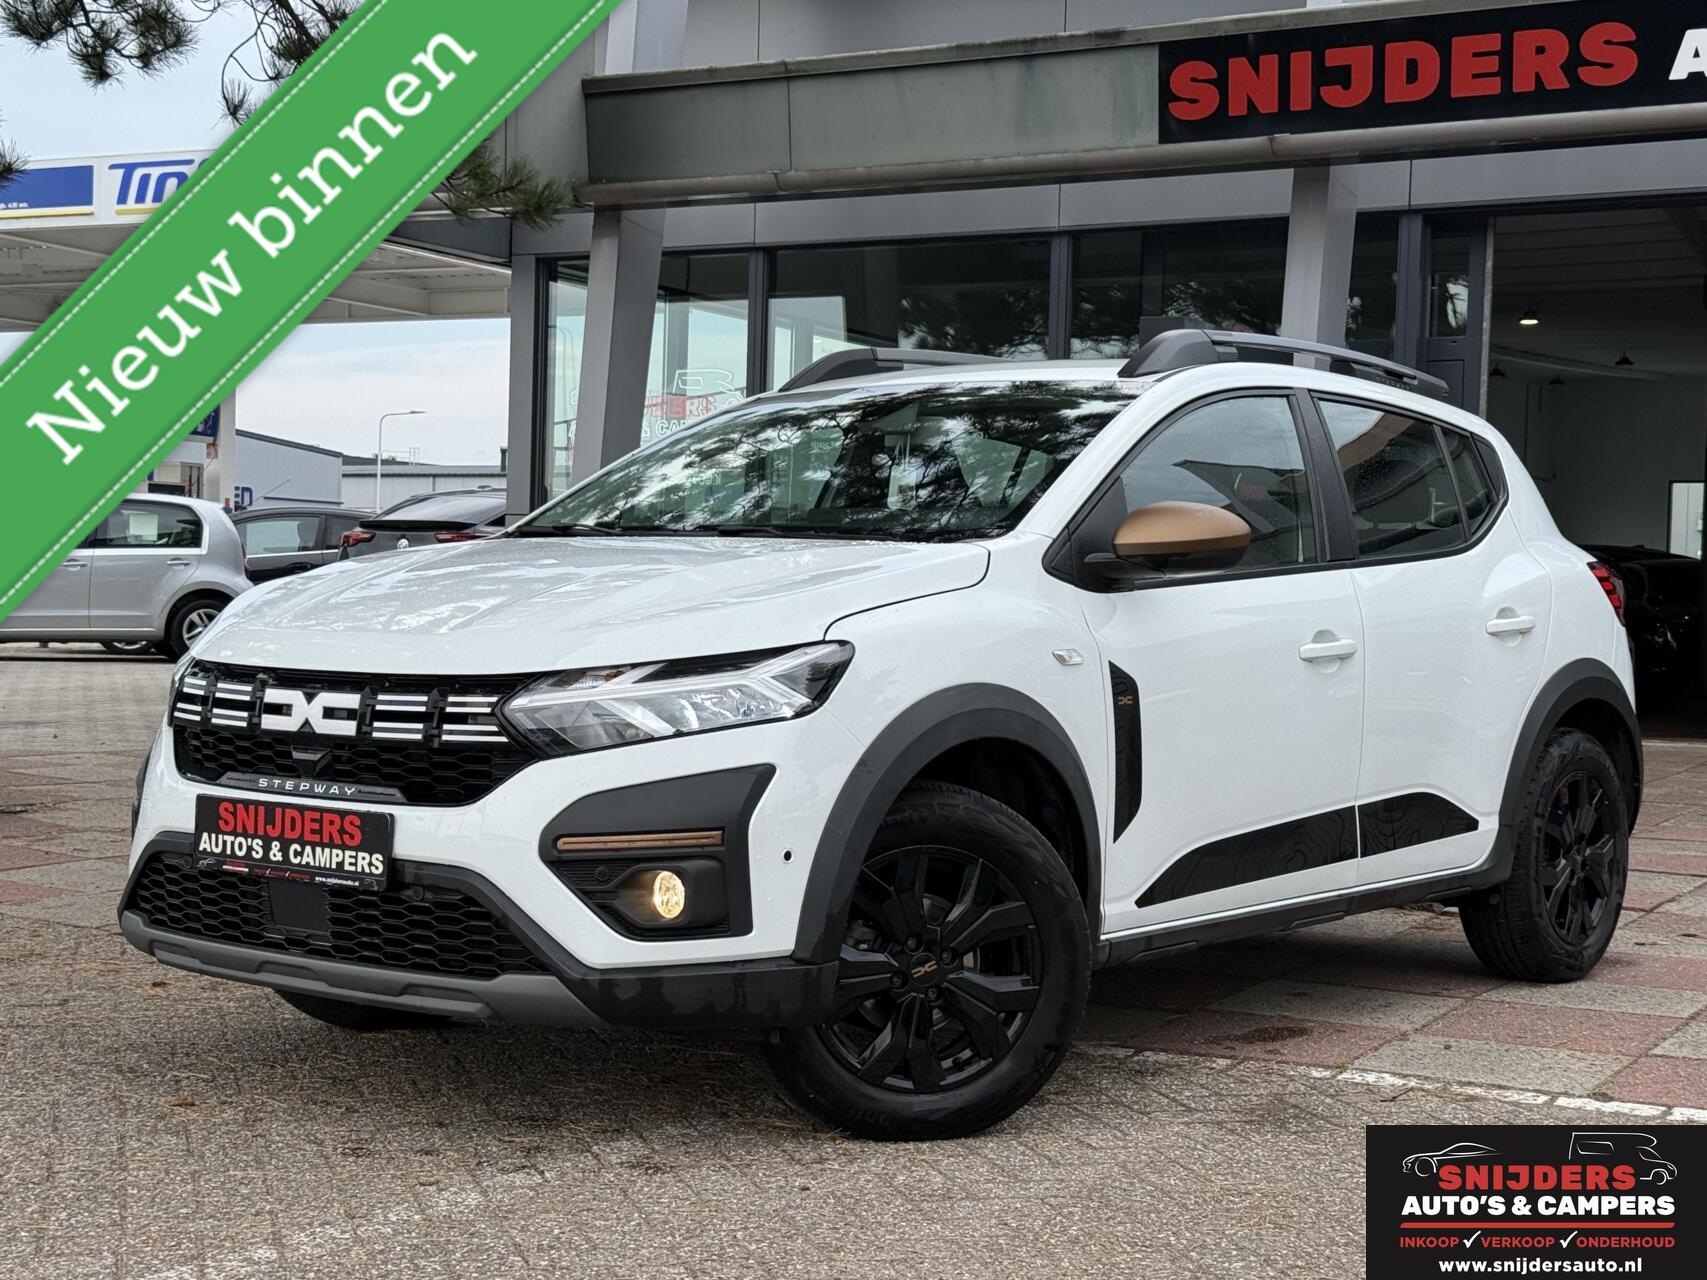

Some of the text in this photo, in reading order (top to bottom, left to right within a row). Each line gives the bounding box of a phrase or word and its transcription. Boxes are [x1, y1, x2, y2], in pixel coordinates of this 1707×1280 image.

[1168, 22, 1639, 121] SNIJDERS
[257, 778, 356, 796] STEPWAY
[217, 801, 363, 847] SNIJDERS
[198, 832, 263, 859] AUTO'S
[269, 841, 283, 862] &
[289, 844, 384, 875] CAMPERS
